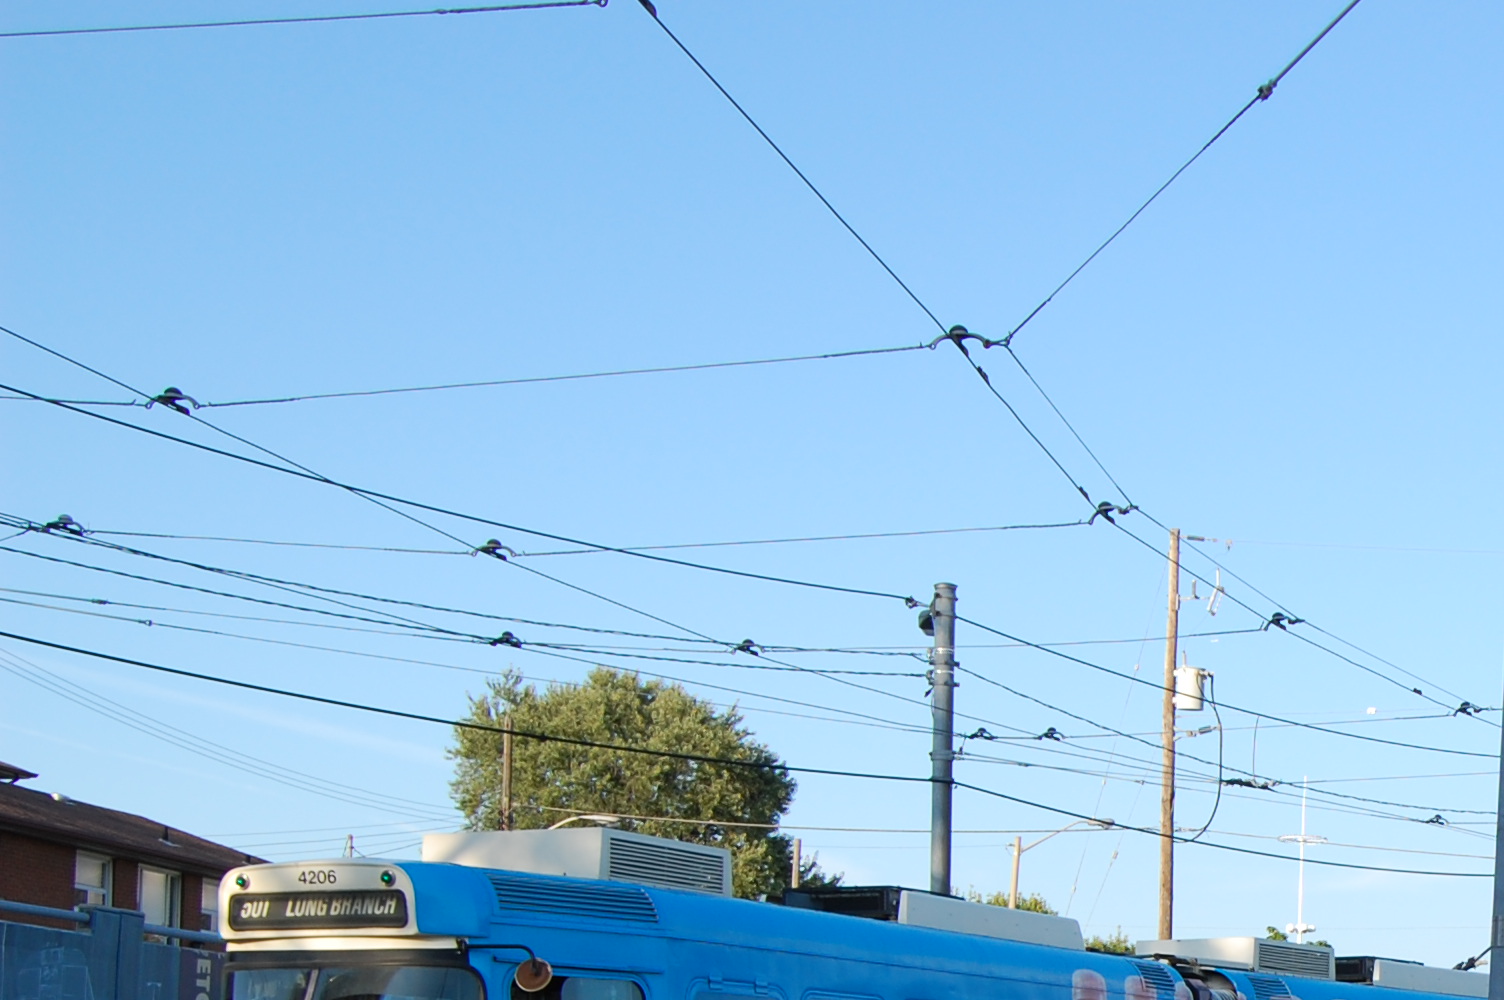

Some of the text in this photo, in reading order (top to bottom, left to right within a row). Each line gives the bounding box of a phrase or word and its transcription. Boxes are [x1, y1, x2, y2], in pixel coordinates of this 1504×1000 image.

[298, 869, 337, 885] 4206
[285, 898, 329, 918] LONG
[330, 893, 397, 916] BRANCH
